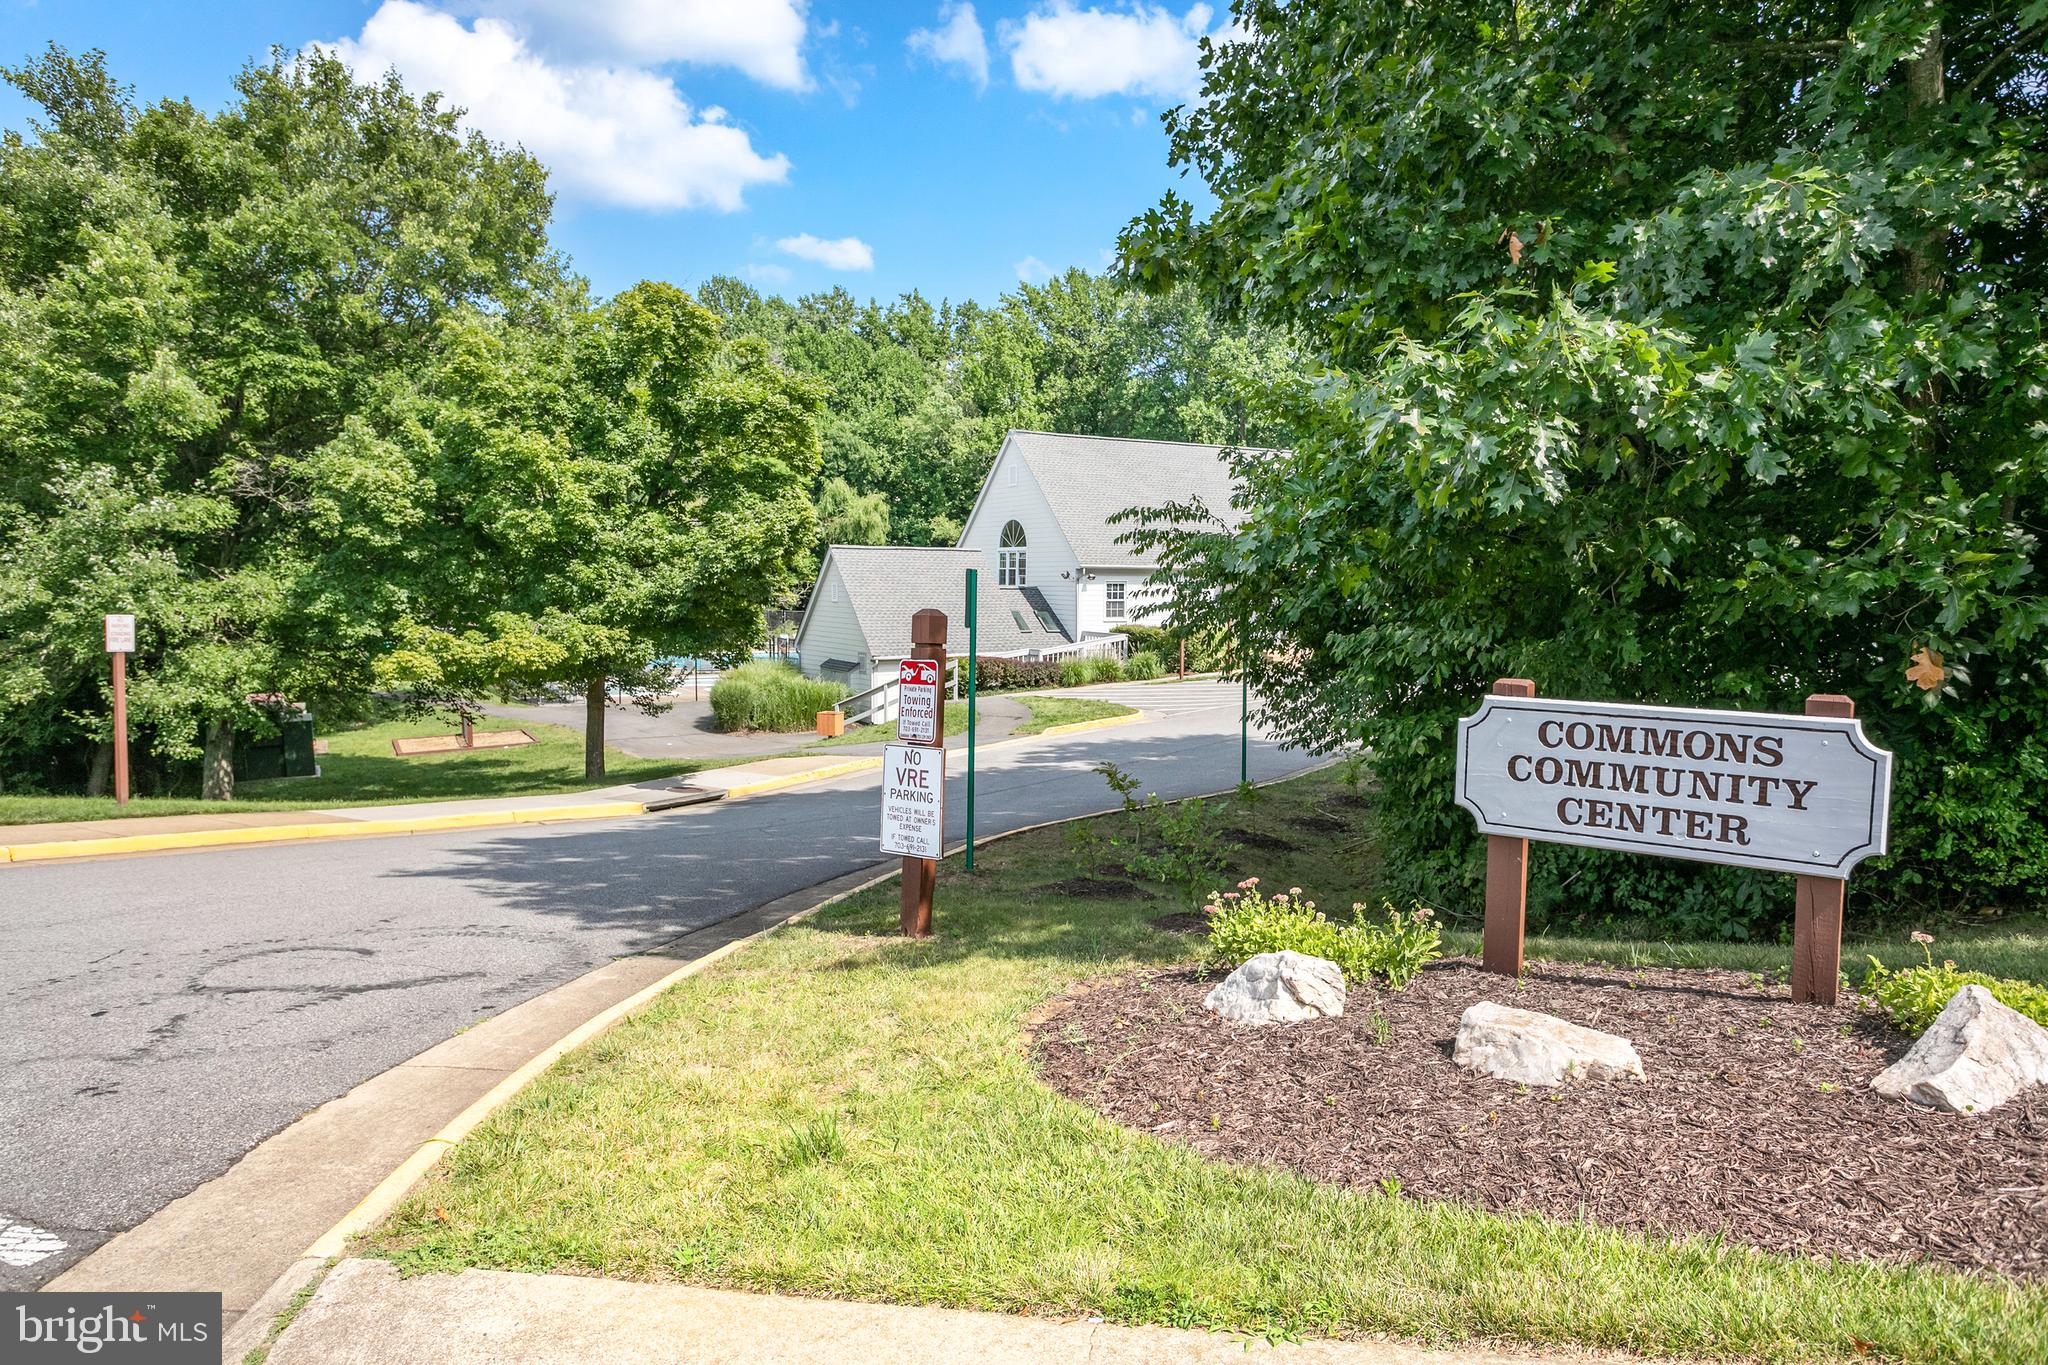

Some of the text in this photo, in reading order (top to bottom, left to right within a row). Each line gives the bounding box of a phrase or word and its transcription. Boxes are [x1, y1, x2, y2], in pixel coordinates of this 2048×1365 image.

[918, 686, 932, 695] Parking
[904, 695, 931, 709] Towing
[901, 706, 933, 719] Enforced
[1537, 720, 1785, 767] COMMONS
[904, 749, 922, 766] NO
[895, 766, 929, 789] VRE
[1507, 754, 1818, 811] COMMUNITY
[890, 788, 934, 804] PARKING
[887, 813, 904, 822] TOWED
[905, 815, 912, 823] AT
[888, 805, 935, 818] VEHICLES WILL BE
[899, 823, 922, 833] EXPENSE
[1556, 797, 1751, 846] CENTER
[898, 834, 915, 843] TOWED
[916, 836, 930, 846] CALL
[895, 841, 928, 853] 703-691-2131
